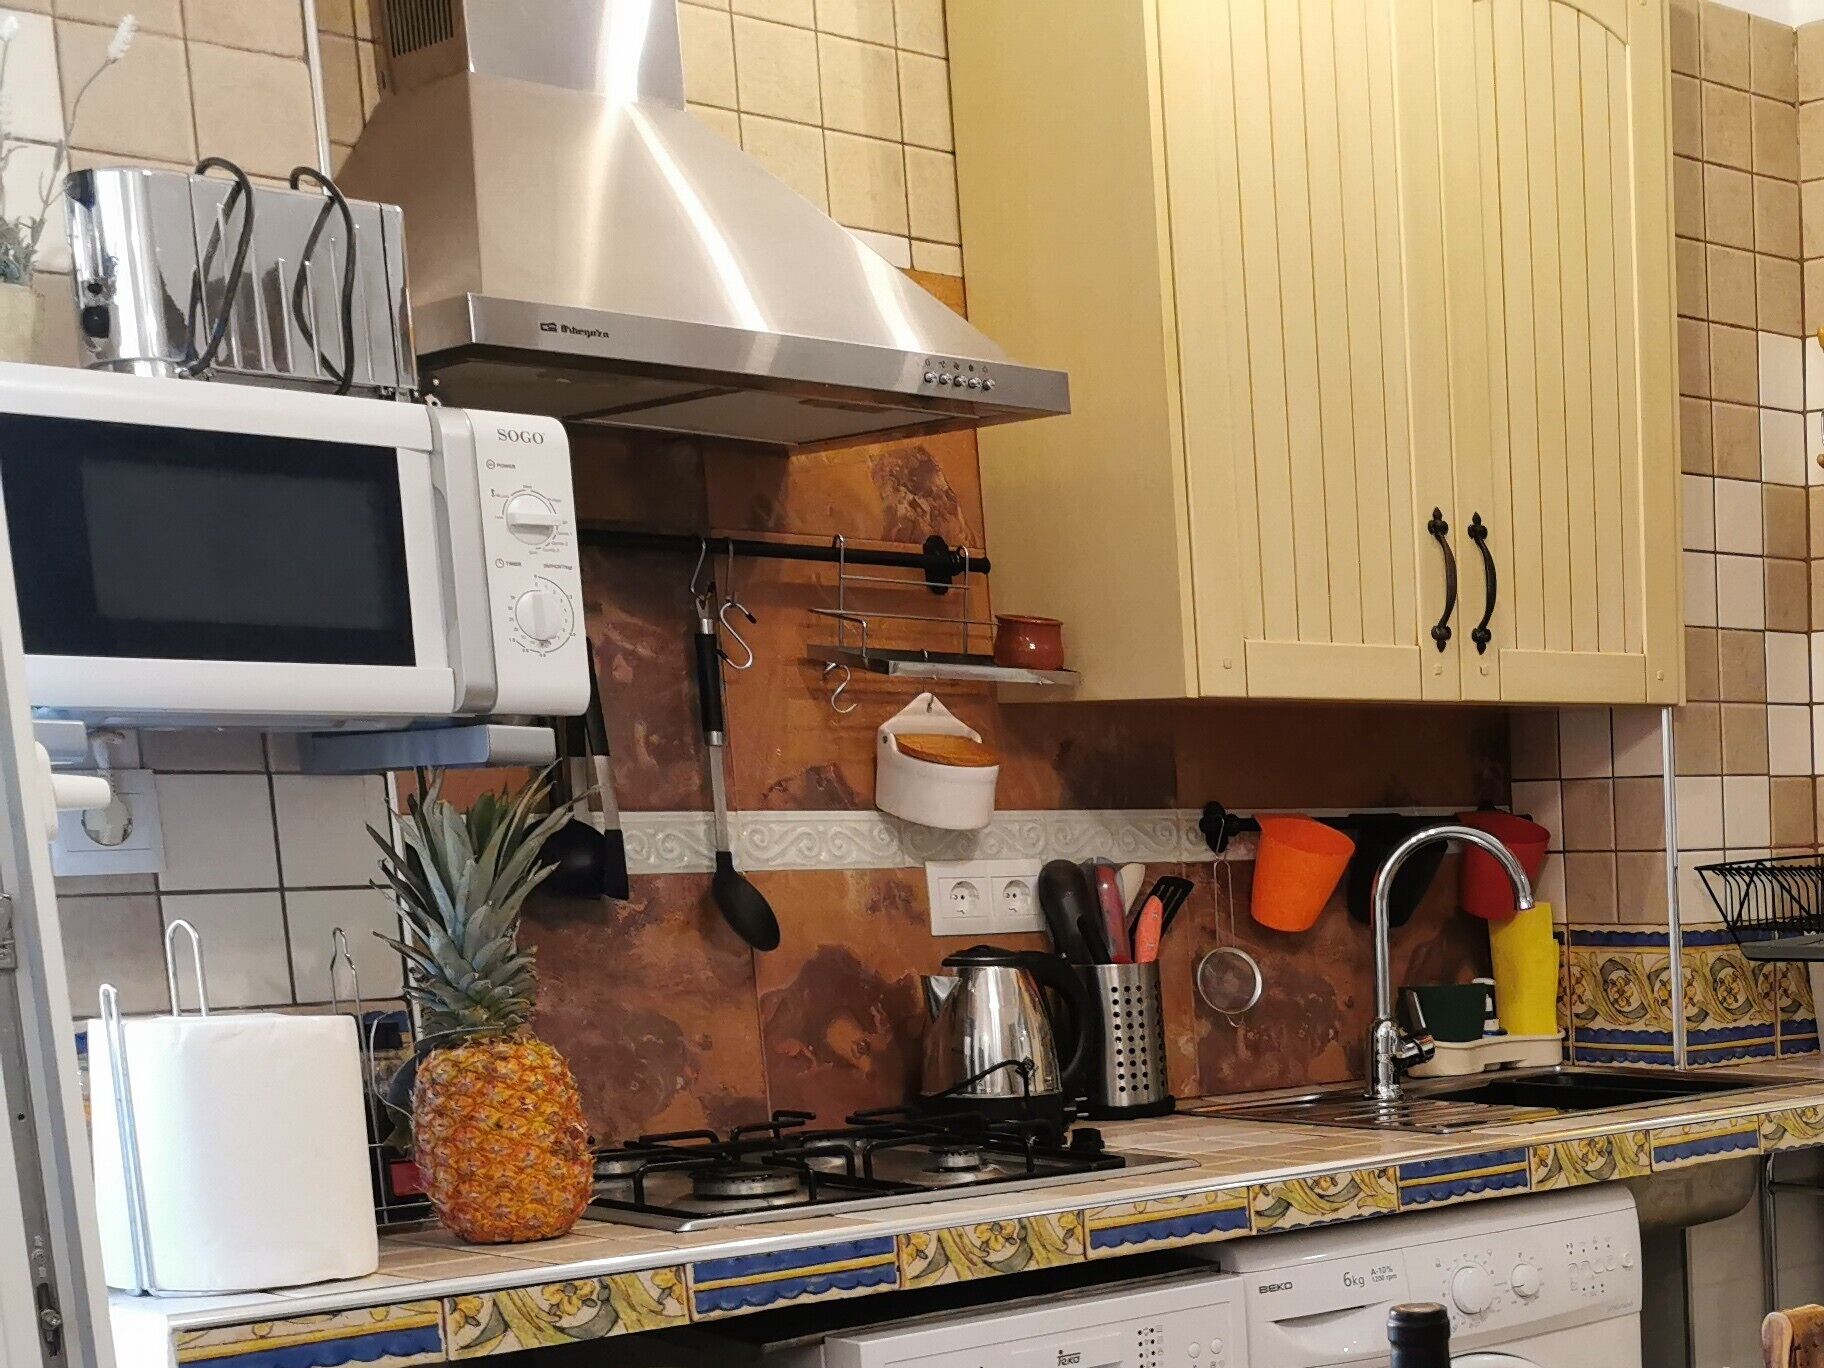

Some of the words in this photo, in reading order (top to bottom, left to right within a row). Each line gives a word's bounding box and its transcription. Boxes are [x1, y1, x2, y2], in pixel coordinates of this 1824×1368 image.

[496, 428, 544, 445] SOGO
[1370, 1265, 1394, 1276] A-10%
[1343, 1271, 1366, 1288] 6kg
[1258, 1281, 1293, 1294] BEKO
